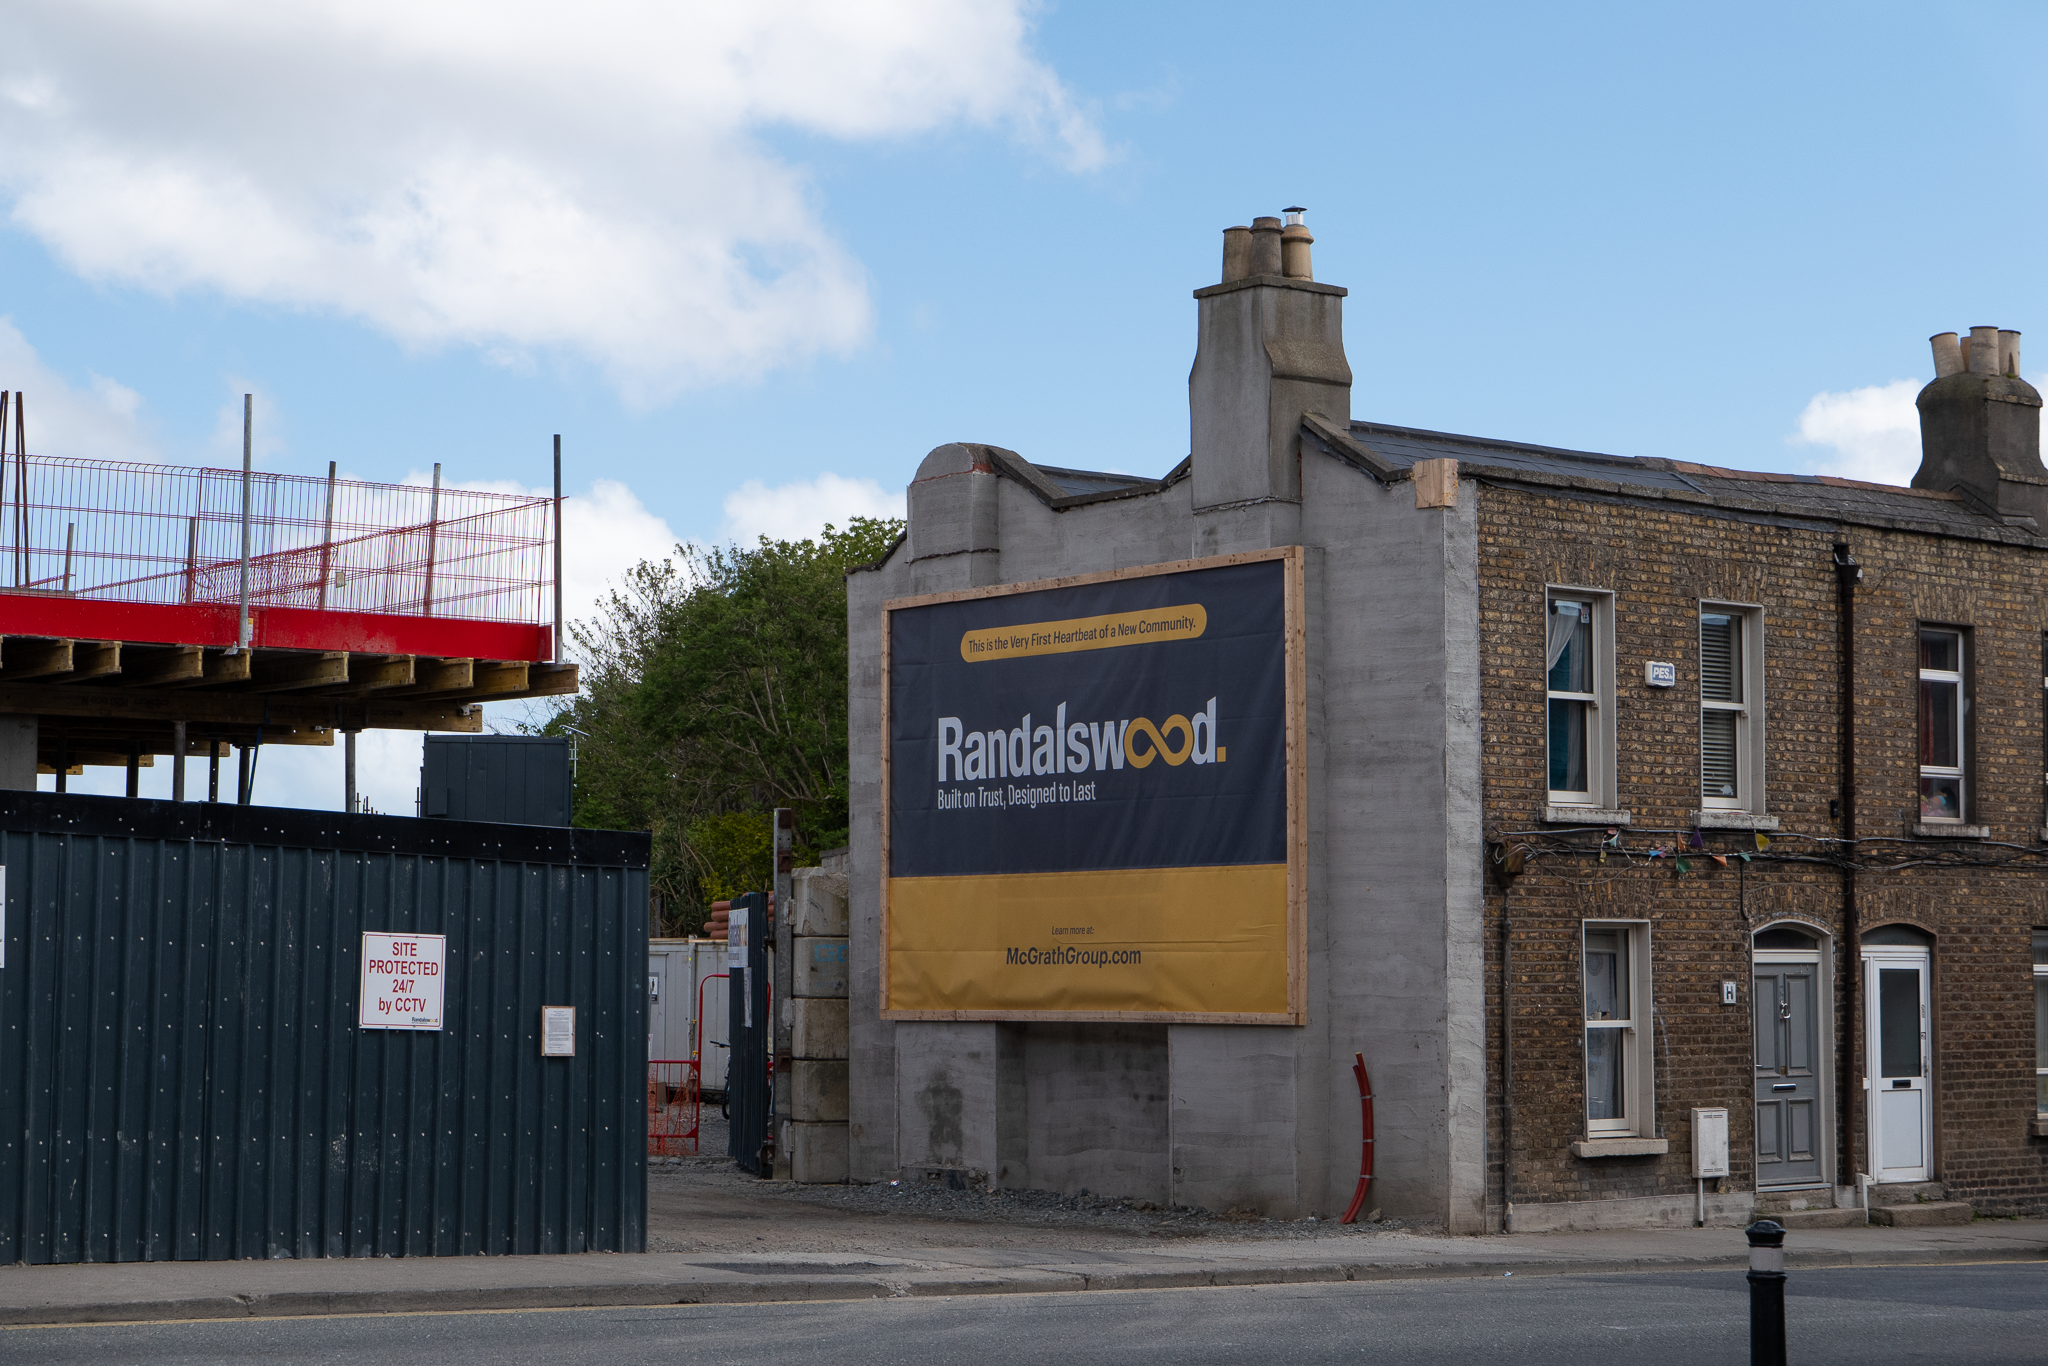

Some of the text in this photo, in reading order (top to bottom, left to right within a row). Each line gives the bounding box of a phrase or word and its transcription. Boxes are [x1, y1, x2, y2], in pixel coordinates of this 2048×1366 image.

[969, 615, 1196, 653] This is the Very First Heartbeat of a New Community.
[937, 780, 1096, 810] Built on Trust, Designed to Last
[1051, 926, 1095, 935] Learn more at:
[392, 942, 417, 957] SITE
[1006, 946, 1141, 969] McGrathGroup.com
[369, 959, 439, 976] PROTECTED
[392, 979, 415, 993] 24/7
[1726, 985, 1734, 1000] H
[378, 997, 426, 1015] by CCTV
